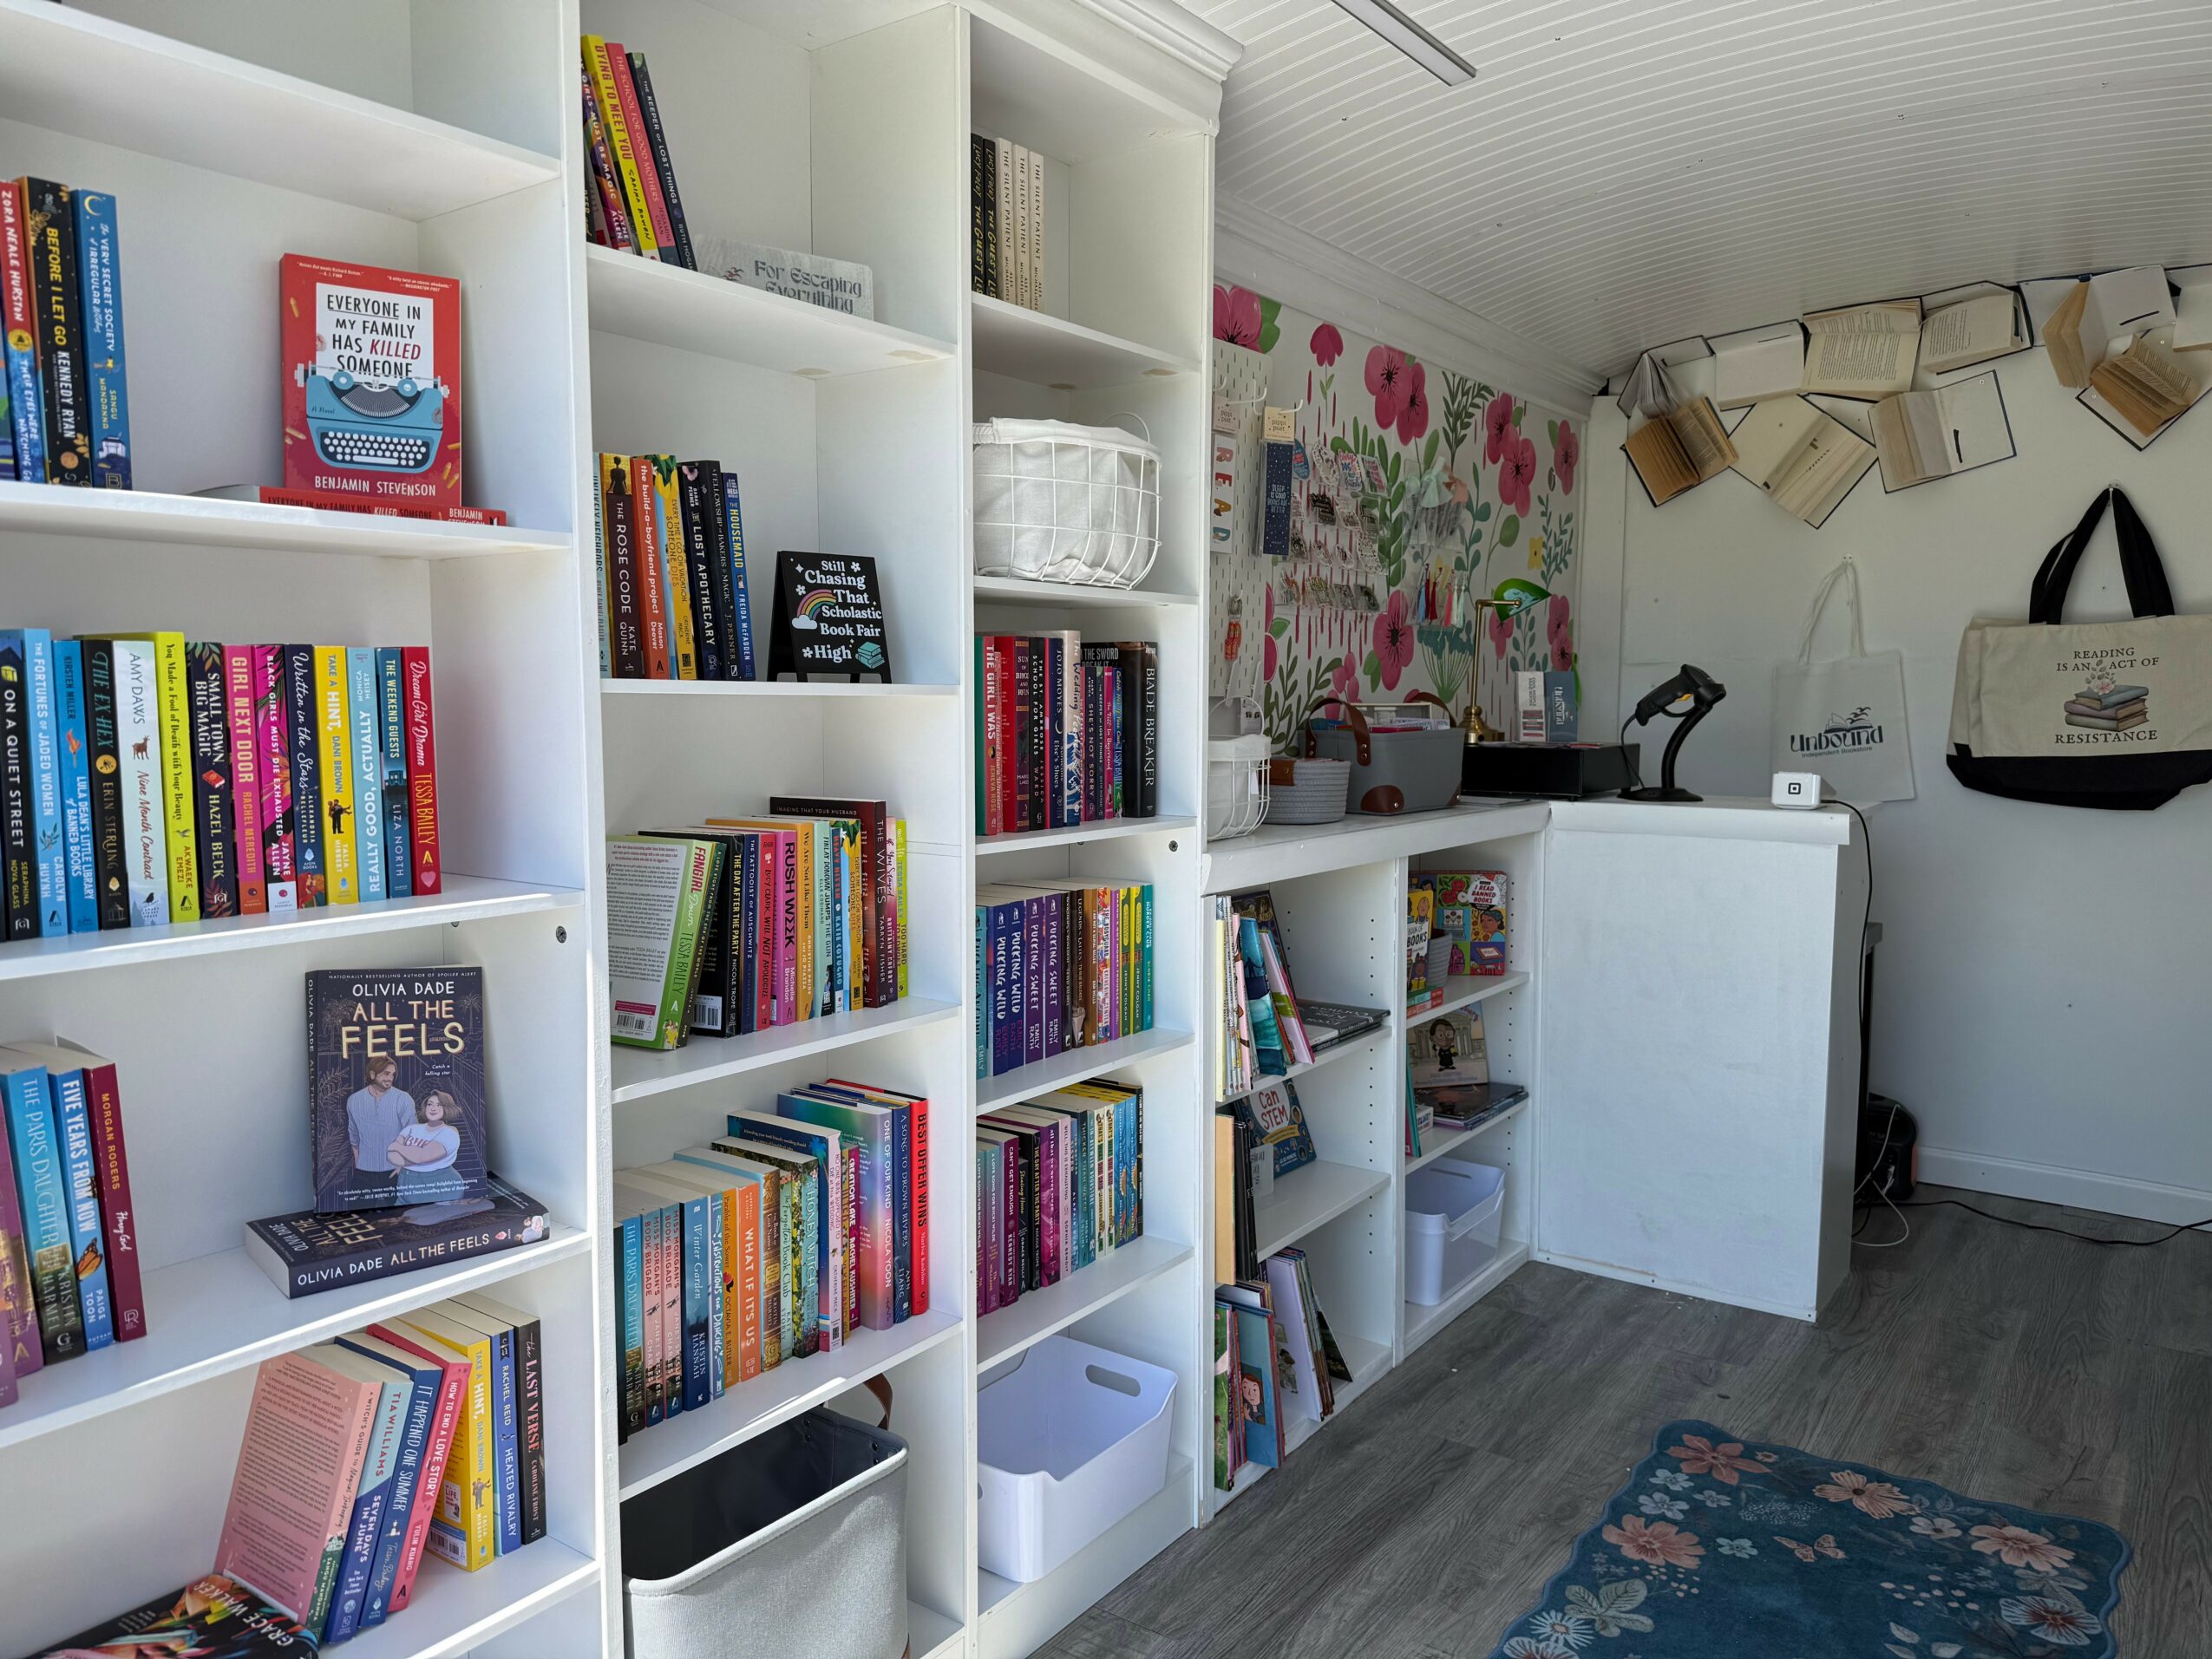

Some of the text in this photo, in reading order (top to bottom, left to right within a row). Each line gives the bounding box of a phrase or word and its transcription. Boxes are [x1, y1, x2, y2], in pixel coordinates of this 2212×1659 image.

[595, 45, 632, 160] DYING TO MEET YOU
[2, 190, 23, 321] ZORA NEALE HURSTON
[45, 227, 62, 281] BEFORE
[101, 238, 110, 264] VERY
[103, 266, 112, 302] SECRET
[755, 260, 862, 298] For Escaping
[52, 297, 65, 321] LET
[327, 295, 421, 320] EVERYONE IN
[54, 324, 67, 346] GO
[105, 304, 115, 351] SOCIETY
[332, 334, 421, 360] HAS KILLED
[336, 319, 415, 339] MY FAMILY
[337, 356, 413, 379] SOMEONE
[58, 351, 75, 438] KENNEDY RYAN
[100, 378, 109, 430] MANDANNA
[315, 476, 436, 496] BENJAMIN STEVENSON
[616, 524, 628, 565] ROSE
[730, 509, 743, 568] HOUSEMAID
[804, 570, 866, 590] Chasing
[821, 560, 845, 572] Still
[618, 570, 631, 614] CODE
[834, 589, 870, 604] That
[820, 623, 881, 637] Book Fair
[821, 605, 882, 619] Scholastic
[619, 622, 628, 656] QUINN
[814, 644, 852, 663] High
[2073, 648, 2135, 660] READING
[2056, 657, 2159, 671] IS AN ACT OF
[64, 656, 76, 719] KIRSTEN MILLER
[129, 653, 145, 724] AMY DAWS
[207, 673, 221, 714] SMALL
[195, 681, 212, 756] BIG MAGIC
[232, 657, 253, 783] GIRL NEXT DOOR
[386, 659, 400, 758] THE WEEKEND GUESTS
[410, 661, 429, 766] Dream Girl Drama
[1144, 668, 1155, 787] BLADE BREAKER
[1790, 725, 1884, 753] Unbound
[1802, 749, 1840, 758] Independent
[2054, 730, 2158, 744] RESISTANCE
[5, 689, 23, 847] ON A QUIET STREET
[359, 710, 381, 892] REALLY GOOD, ACTUALLY
[416, 773, 435, 844] TESSA BAILEY
[209, 794, 224, 879] HAZEL BECK
[393, 804, 404, 876] LIZA NORTH
[876, 820, 887, 905] THE WIVES
[878, 915, 887, 949] TARRYN
[1407, 931, 1427, 948] BOOKS
[352, 981, 455, 996] OLIVIA DADE
[353, 1000, 455, 1022] ALL THE
[341, 1022, 465, 1060] FEELS
[1259, 1090, 1279, 1109] Can
[1261, 1105, 1288, 1130] STEM
[63, 1080, 96, 1232] FIVE YEARS FROM NOW
[101, 1093, 121, 1191] MORGAN ROGERS
[917, 1114, 927, 1228] BEST OFFER WINS
[298, 1234, 489, 1286] OLIVIA DADE ALL THE FEELS
[744, 1227, 756, 1270] WHAT
[745, 1273, 755, 1290] IF
[86, 1293, 95, 1323] TOON
[95, 1290, 106, 1320] PAIGE
[745, 1326, 755, 1347] US
[502, 1365, 512, 1426] RACHEL REID
[376, 1392, 402, 1477] TIA WILLIAMS
[505, 1449, 516, 1537] HEATED RIVALRY
[354, 1506, 370, 1552] IN JUNE
[360, 1495, 382, 1563] SEVEN DAYS
